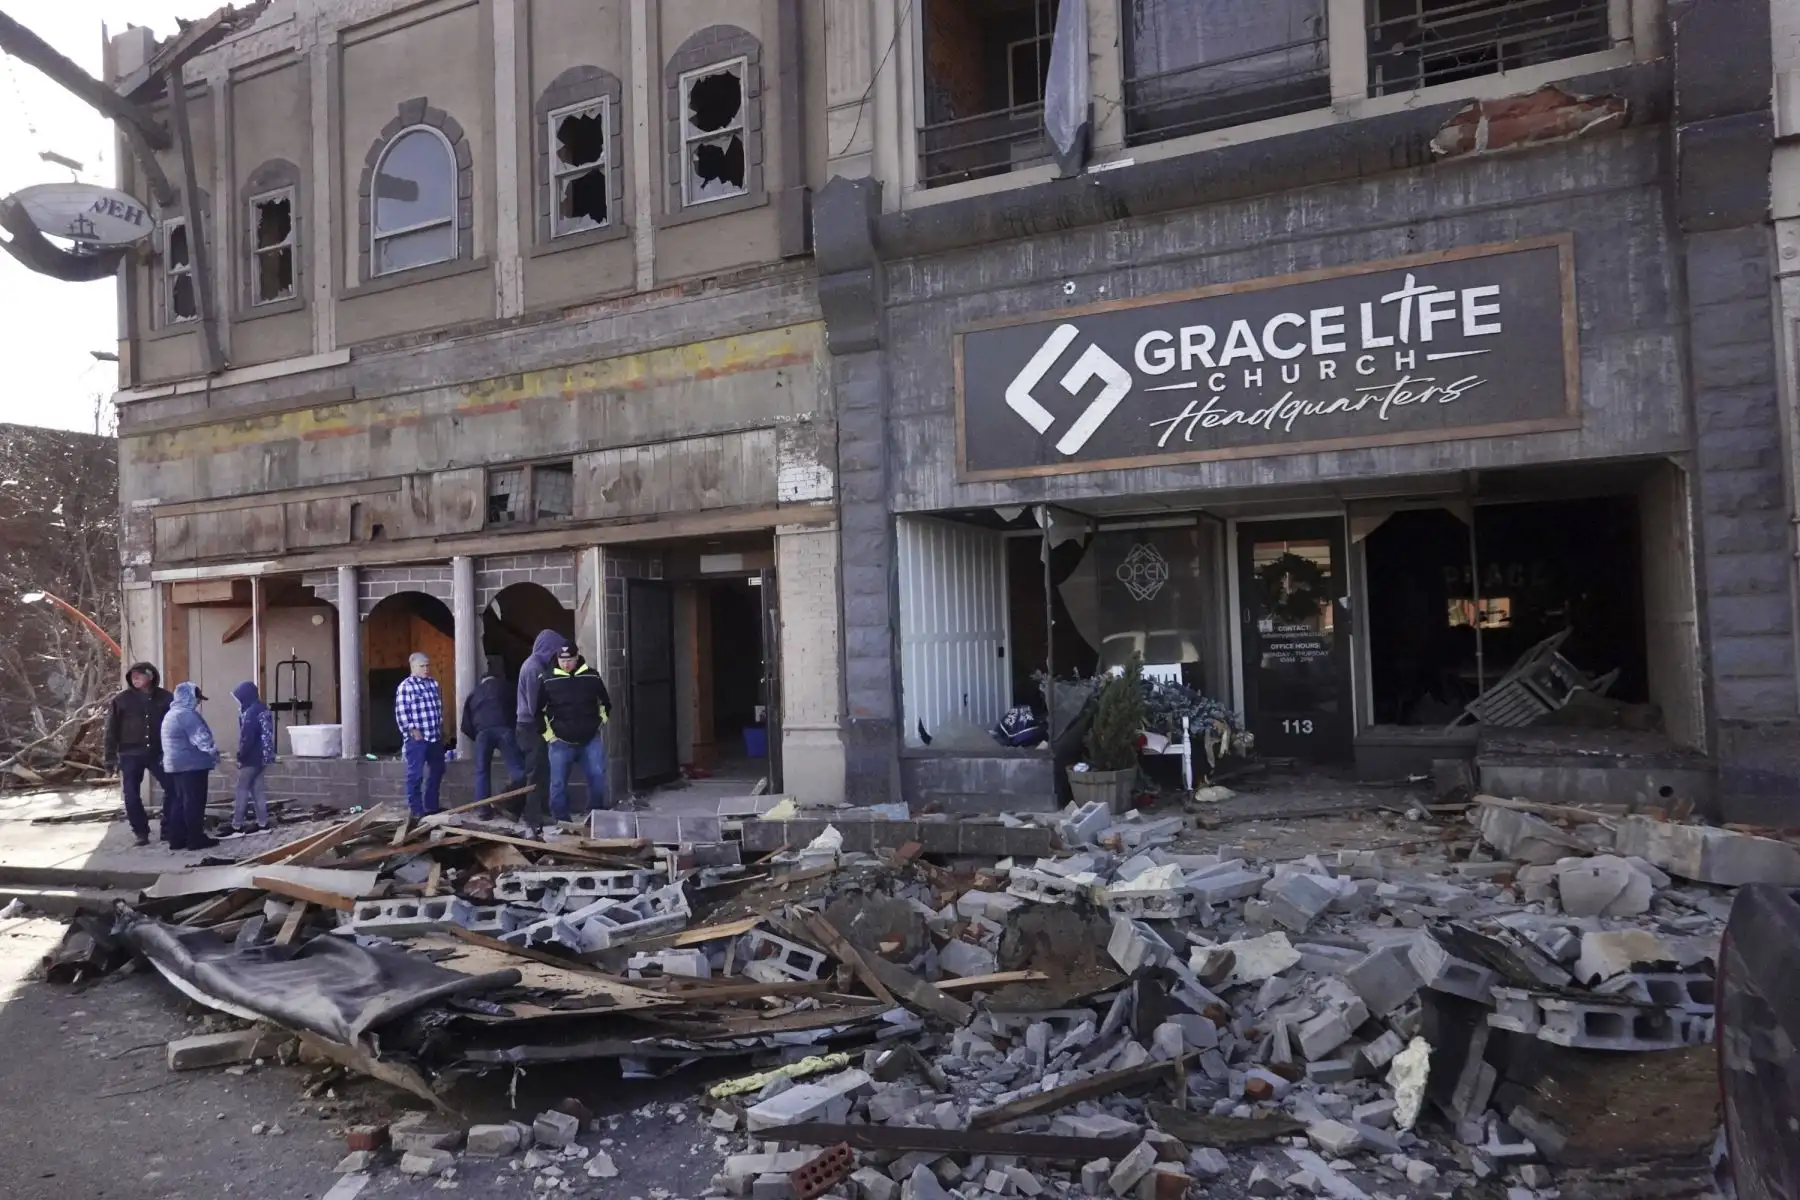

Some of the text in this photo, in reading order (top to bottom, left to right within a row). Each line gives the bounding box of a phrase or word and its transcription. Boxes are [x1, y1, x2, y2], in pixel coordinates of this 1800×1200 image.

[1134, 272, 1502, 375] GRACE LIFE
[1209, 349, 1416, 393] CHURCH
[1150, 374, 1488, 448] Headquarters
[1115, 561, 1169, 582] OPEN
[1282, 719, 1314, 734] 113
